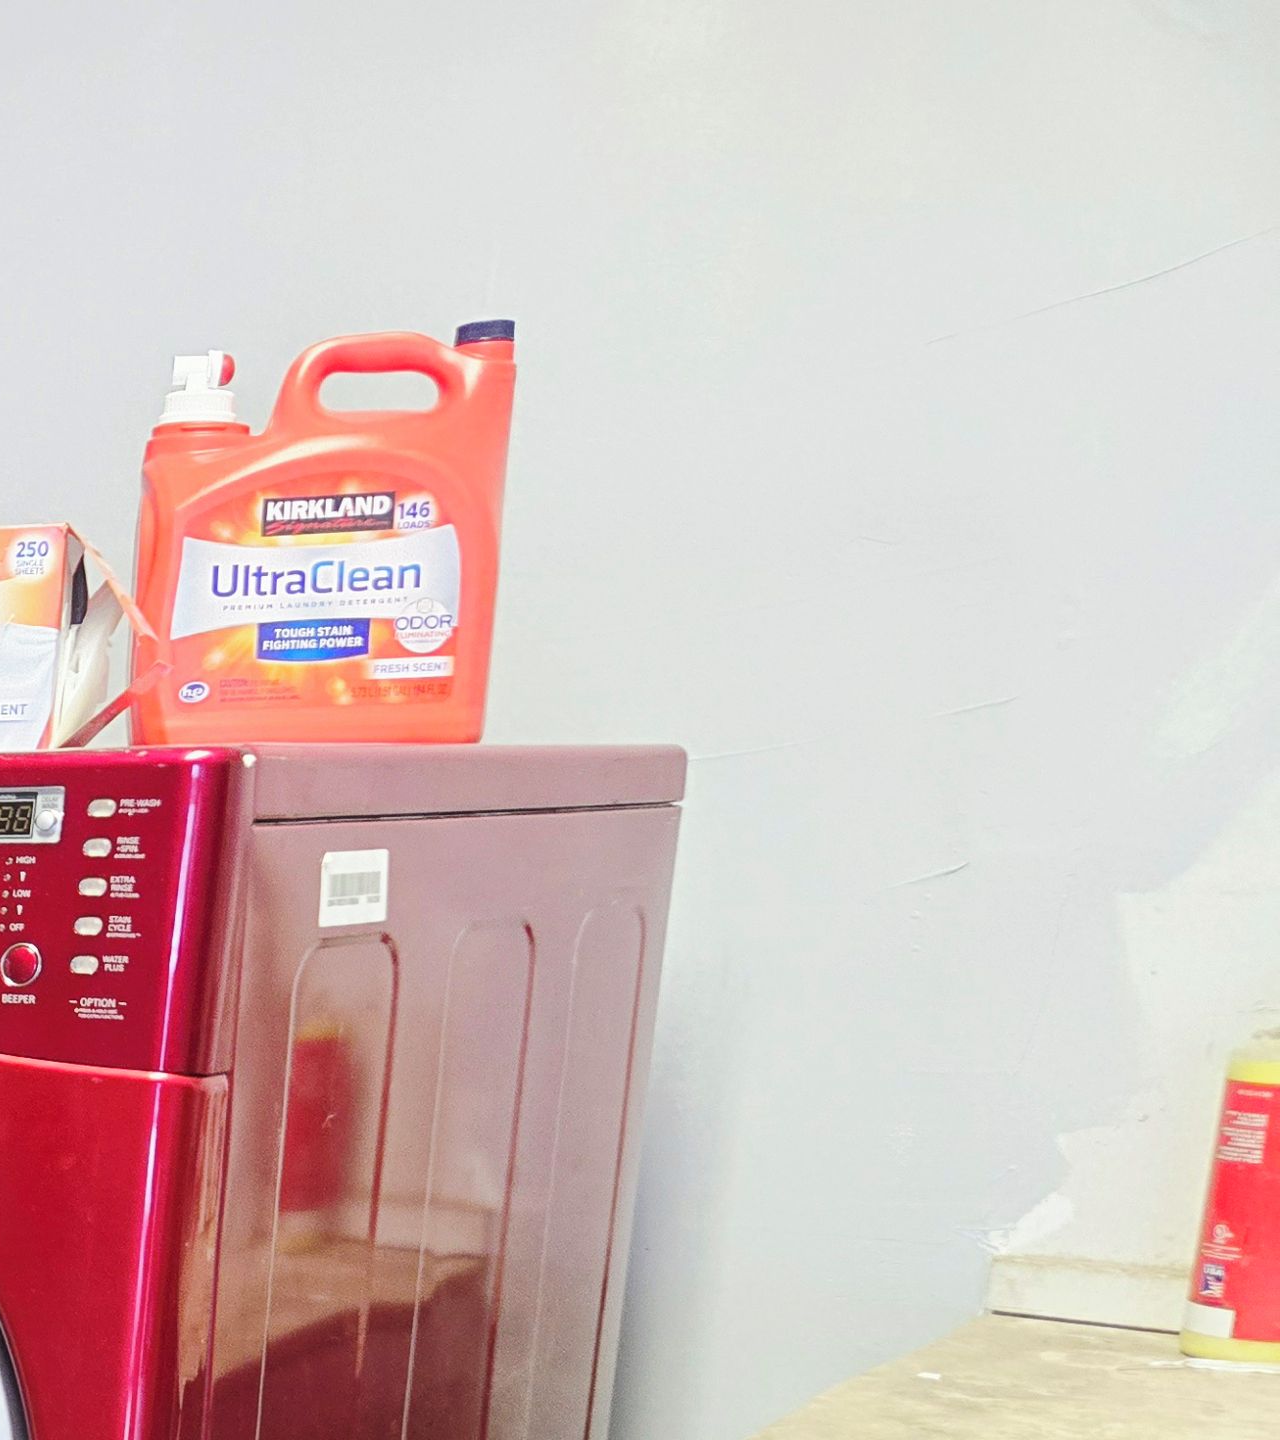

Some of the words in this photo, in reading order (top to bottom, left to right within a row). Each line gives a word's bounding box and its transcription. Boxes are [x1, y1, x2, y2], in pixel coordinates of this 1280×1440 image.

[266, 495, 393, 522] KIRKLAND
[397, 501, 431, 520] 146
[265, 517, 389, 535] Signature
[16, 541, 49, 558] 250
[211, 560, 422, 598] UltraClean
[222, 603, 274, 612] PREMIUM
[280, 601, 334, 610] LAUNDRY
[339, 597, 409, 607] DETERGENT
[395, 614, 453, 631] ODOR
[274, 627, 315, 639] TOUGH
[317, 625, 354, 637] STAIN
[262, 639, 318, 651] FIGHTING
[319, 636, 364, 649] POWER
[373, 663, 410, 674] FRESH
[412, 661, 449, 673] SCENT
[120, 798, 162, 807] PRE-WASH
[15, 856, 37, 864] HIGH
[109, 875, 136, 883] EXTRA
[12, 889, 32, 898] LOW
[108, 916, 132, 924] STAIN
[9, 923, 25, 931] OFF
[108, 924, 132, 932] CYCLE
[104, 963, 125, 972] PLUS
[1, 993, 36, 1004] BEEPER
[79, 997, 117, 1008] OPTION
